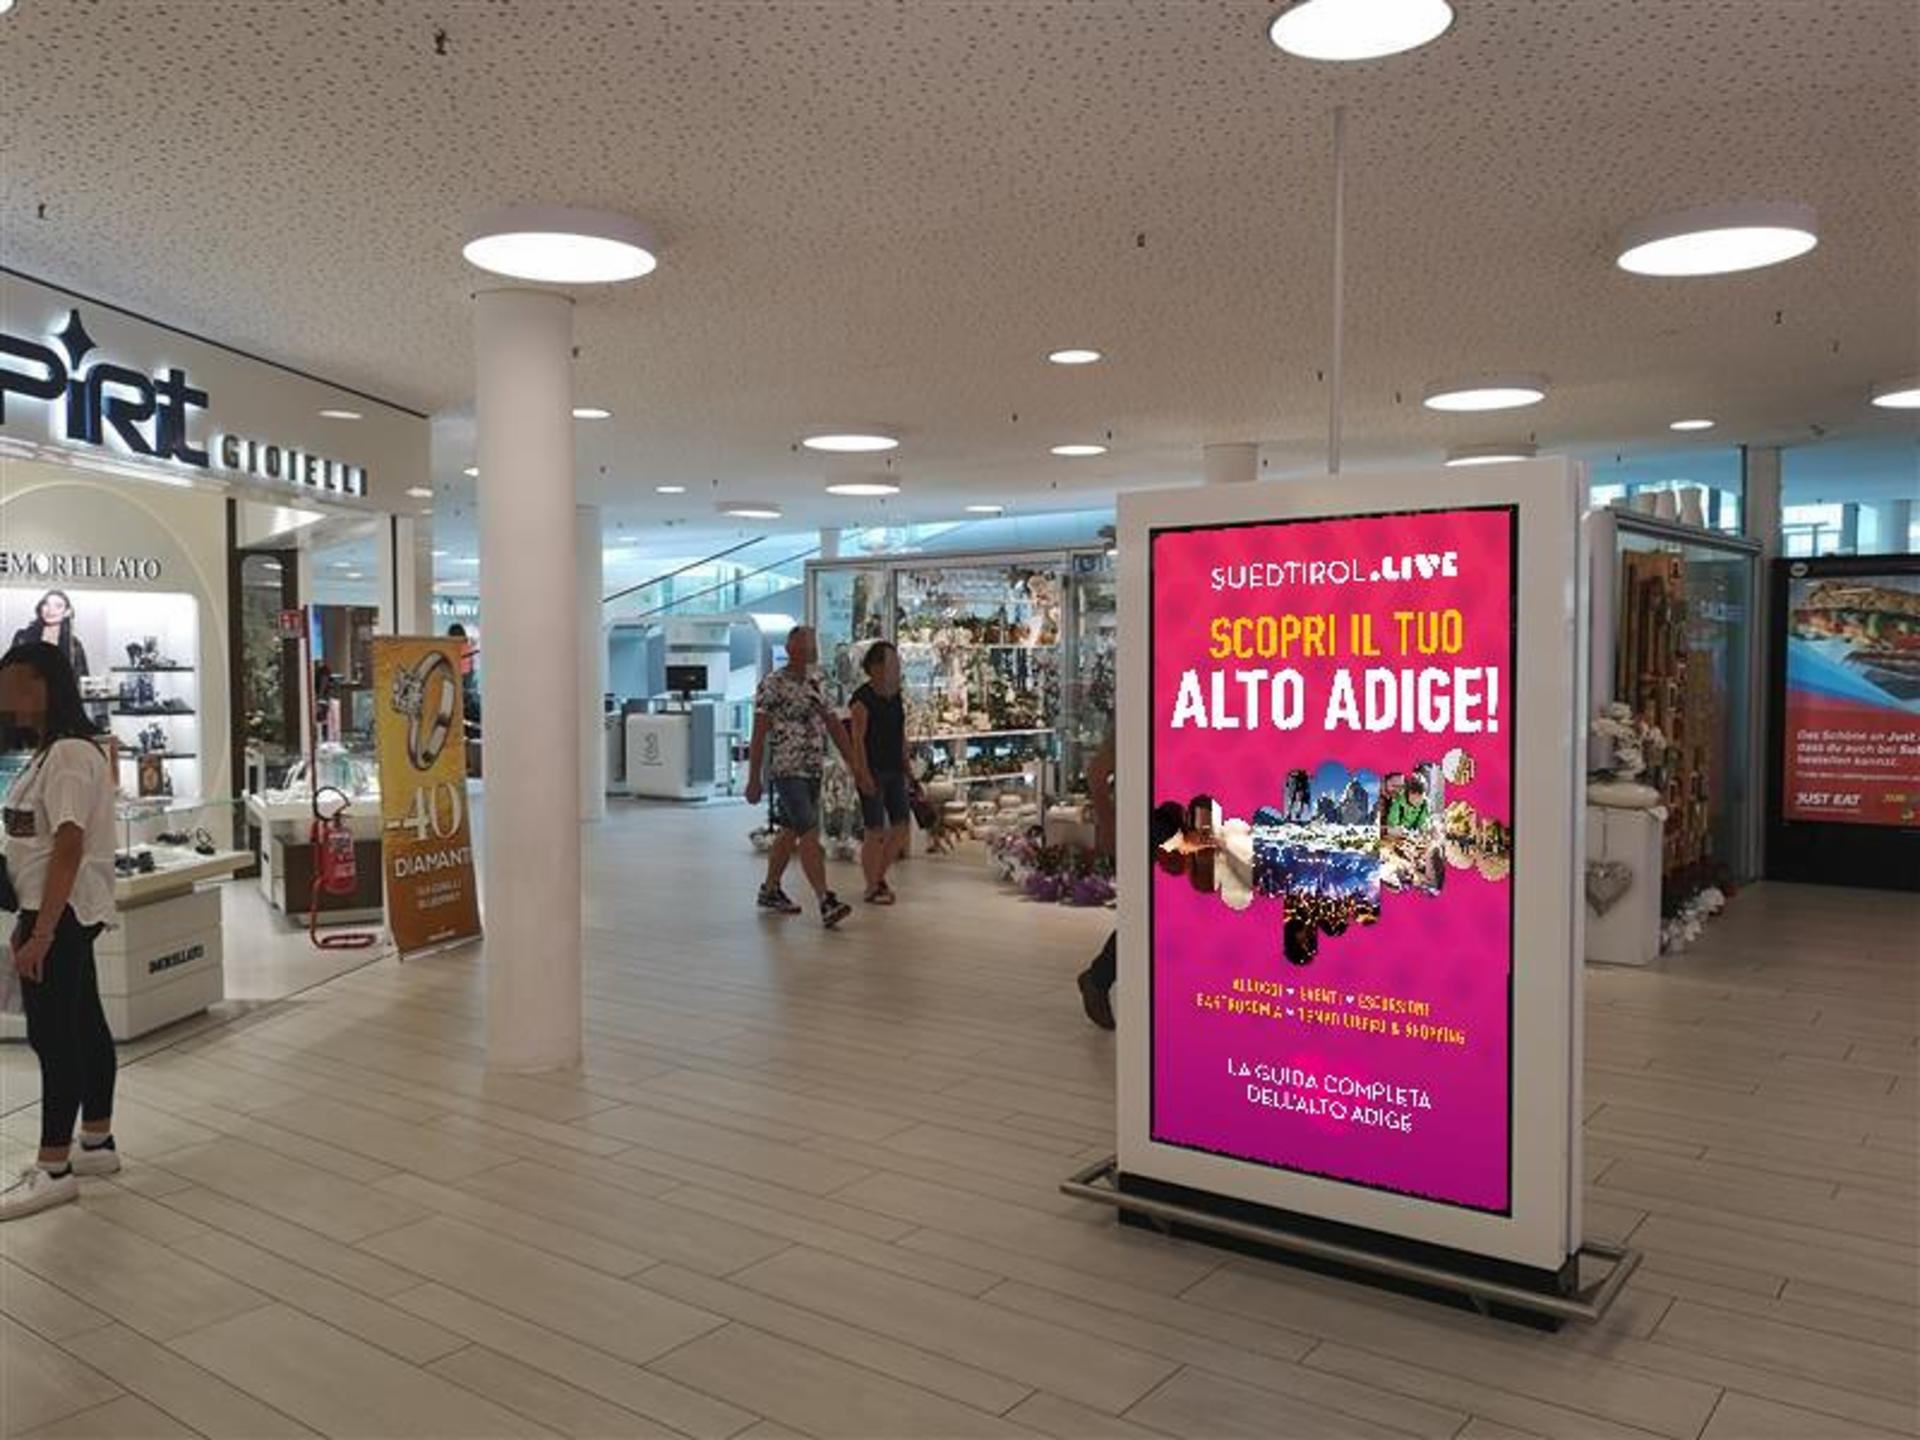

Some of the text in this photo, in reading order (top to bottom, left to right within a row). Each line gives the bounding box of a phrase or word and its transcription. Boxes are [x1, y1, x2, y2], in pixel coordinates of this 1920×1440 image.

[222, 434, 368, 497] GIOIELLI
[11, 552, 162, 580] MORELLATO
[1209, 608, 1463, 659] SCOPRI IL TUO
[1170, 666, 1499, 734] ALTO ADIGE!
[1796, 791, 1861, 806] JUST EAT
[1227, 1057, 1432, 1110] LA GUIDA COMPLETA
[1247, 1083, 1412, 1134] DELL'ALTO ADIGE
